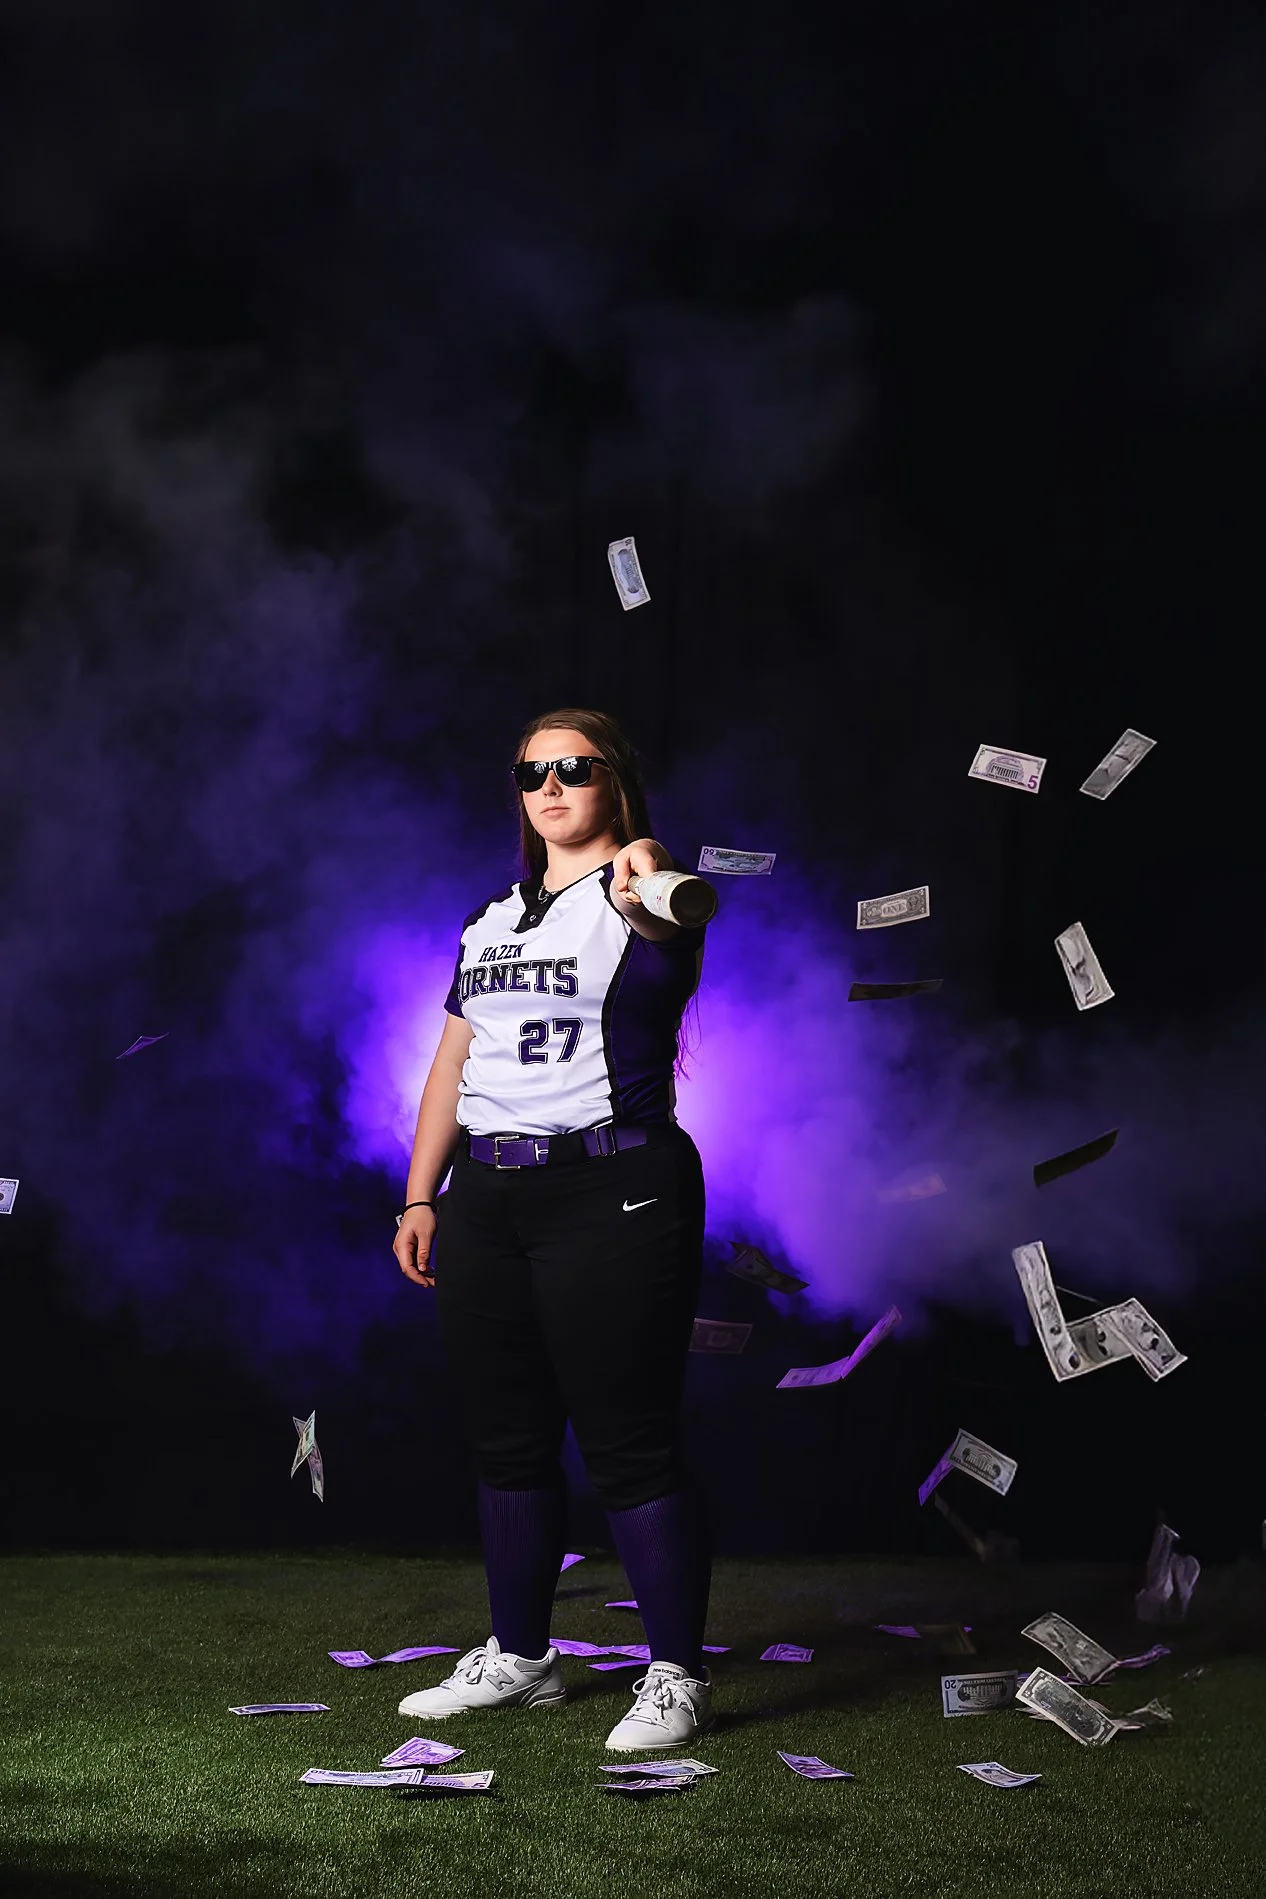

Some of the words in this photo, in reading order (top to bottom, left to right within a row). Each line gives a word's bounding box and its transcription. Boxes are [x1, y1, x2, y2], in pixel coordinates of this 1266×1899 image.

[1027, 775, 1039, 790] 5
[478, 943, 527, 963] HAZEN
[458, 957, 579, 1004] ORNETS
[518, 1017, 584, 1065] 27
